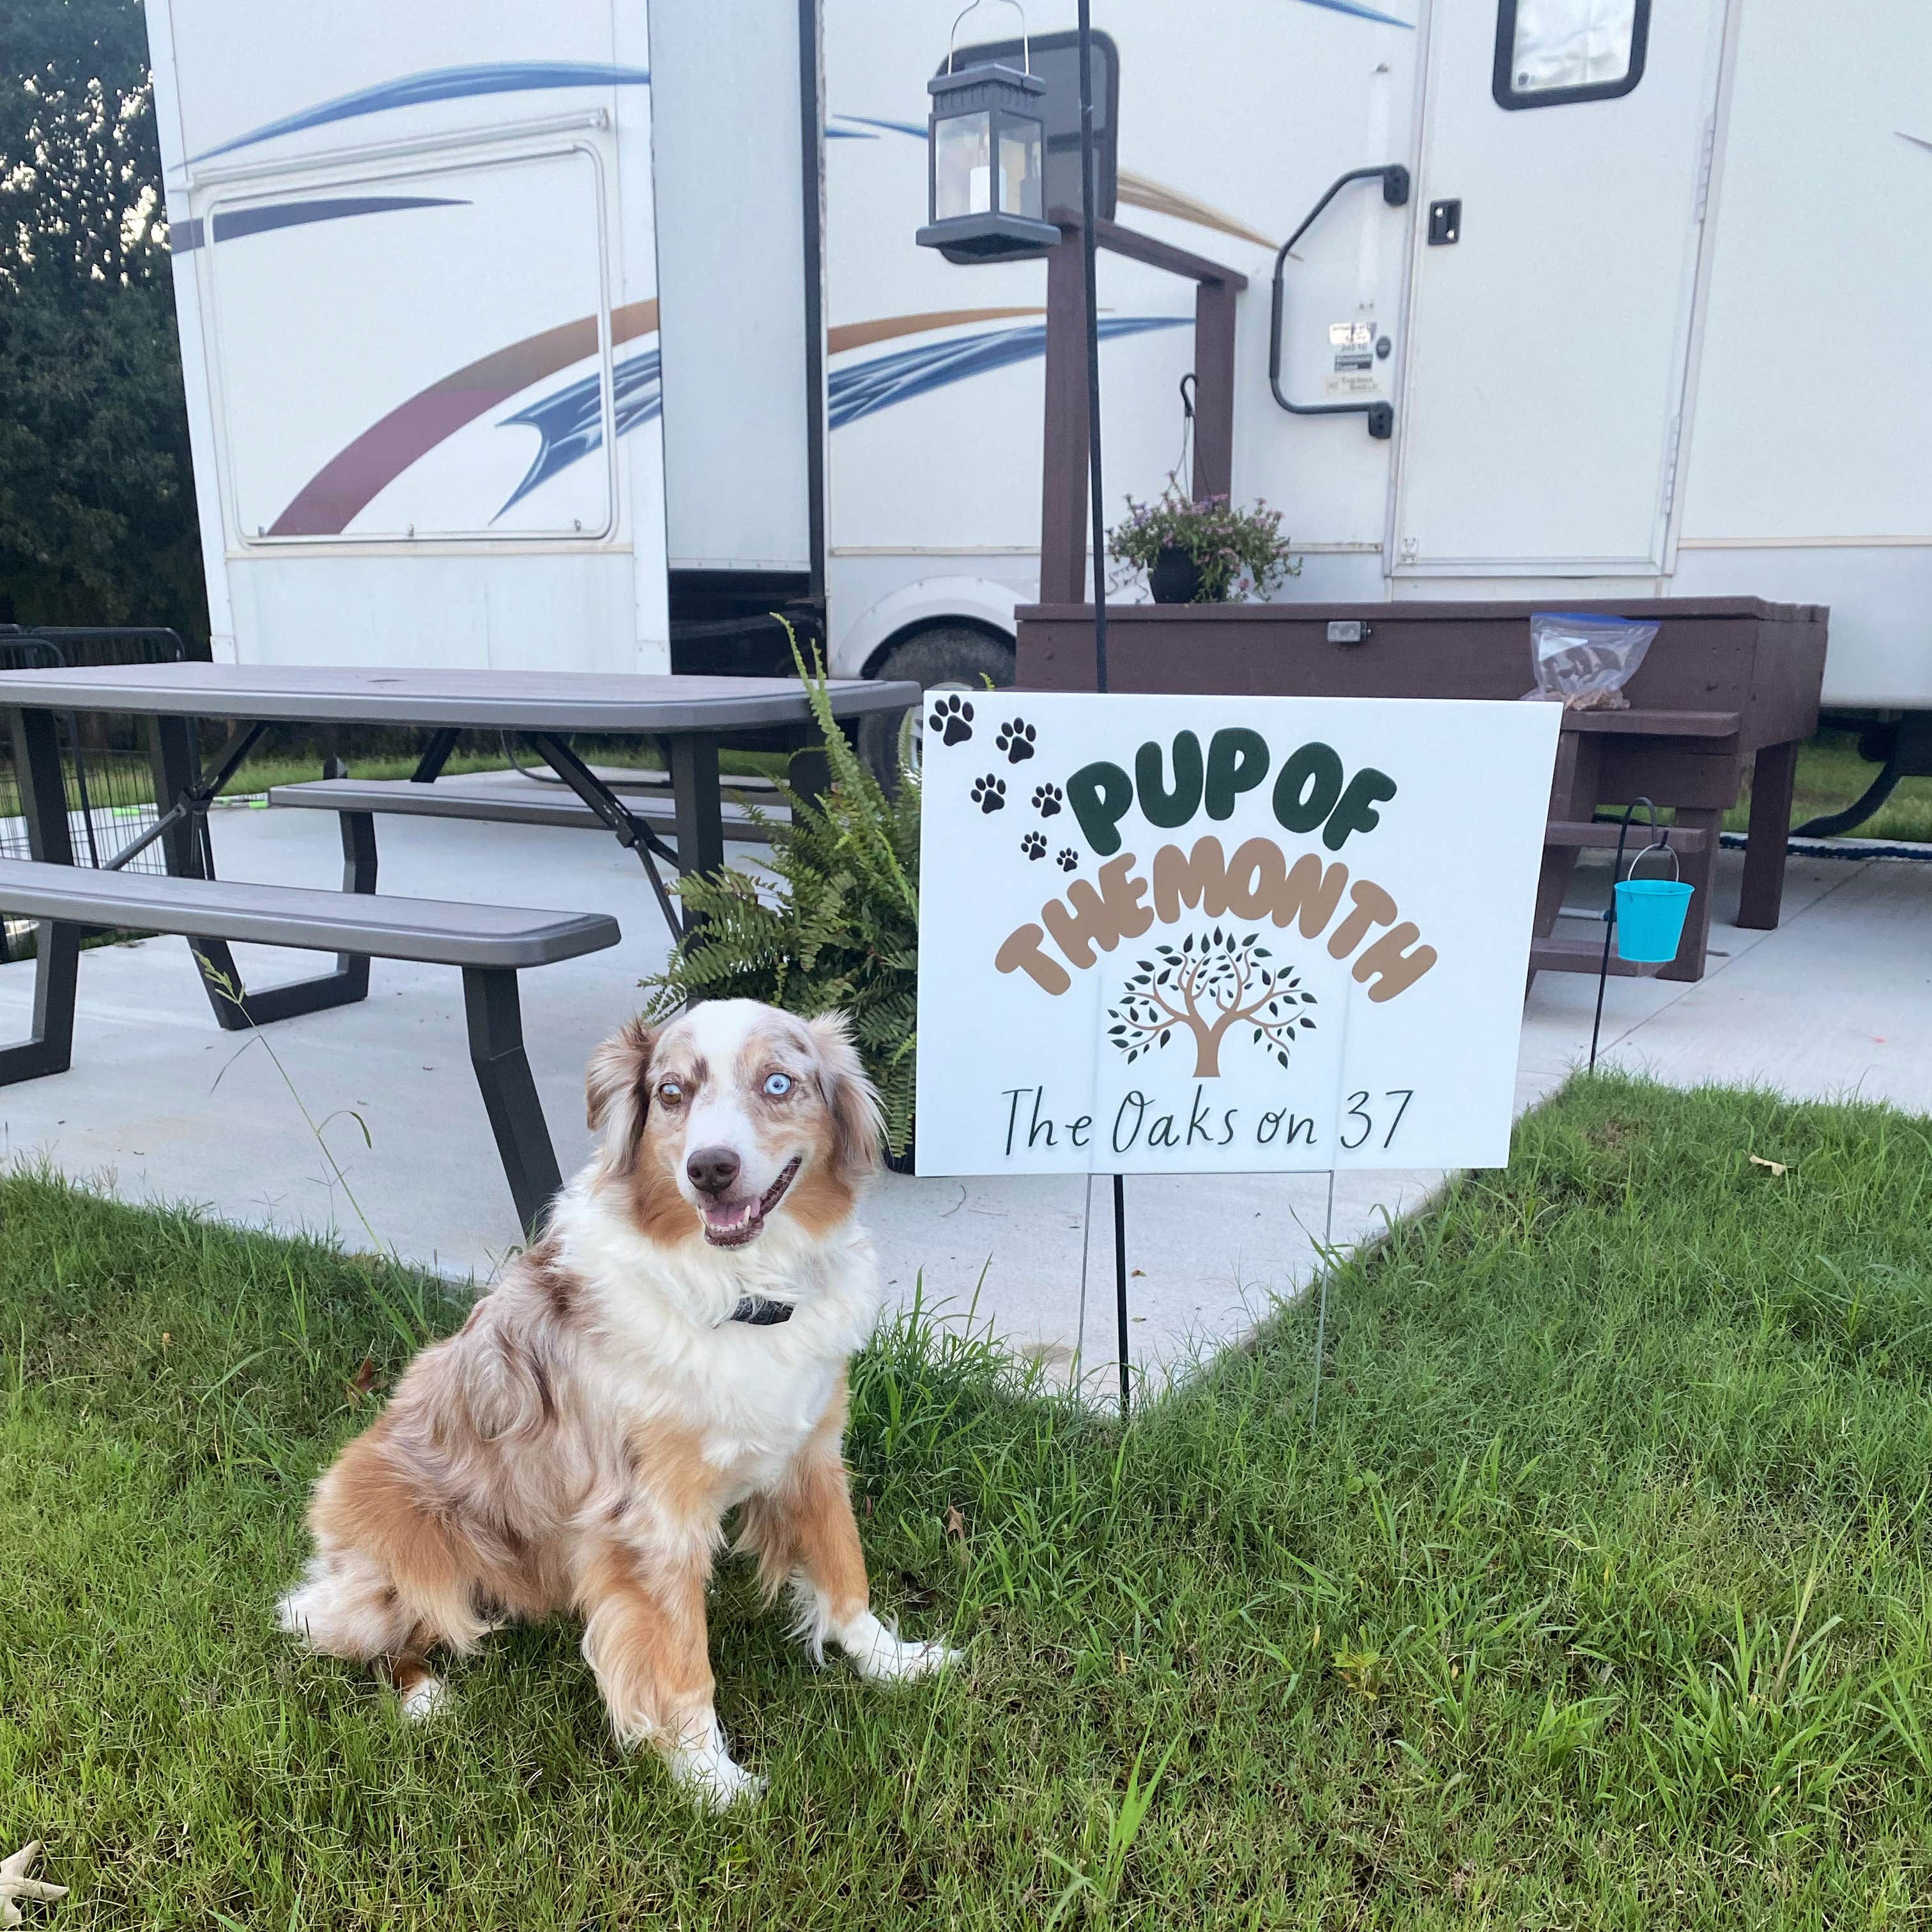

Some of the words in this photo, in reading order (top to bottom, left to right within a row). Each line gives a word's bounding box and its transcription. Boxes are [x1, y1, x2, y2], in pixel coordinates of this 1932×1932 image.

[1066, 727, 1270, 856] PUP
[1273, 742, 1397, 851] OF
[995, 853, 1154, 995] THE
[1153, 836, 1438, 1002] MONTH
[1001, 1085, 1092, 1156] The
[1112, 1084, 1239, 1153] Oaks
[1257, 1107, 1318, 1144] on
[1340, 1090, 1413, 1149] 37
